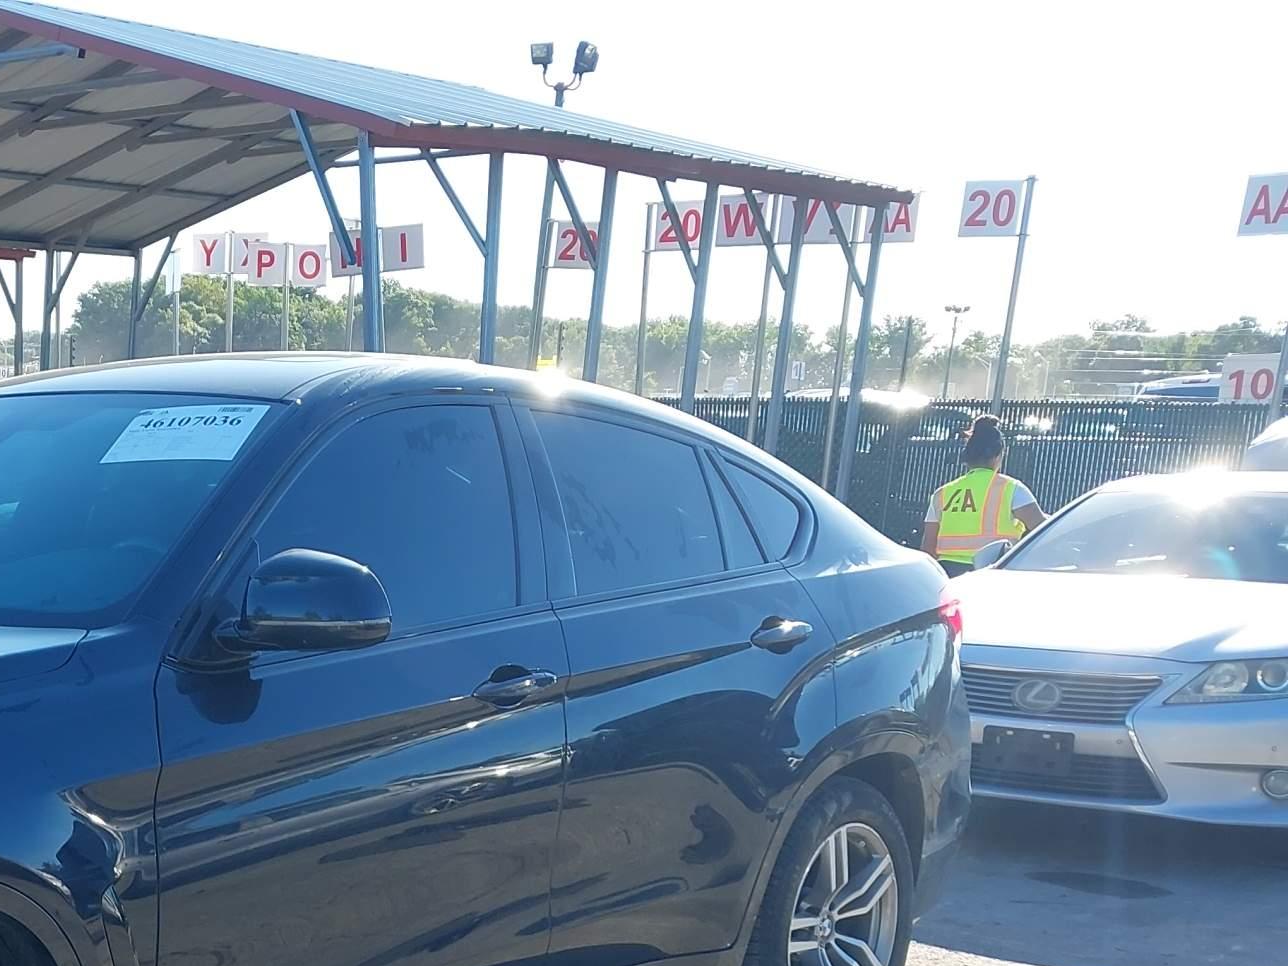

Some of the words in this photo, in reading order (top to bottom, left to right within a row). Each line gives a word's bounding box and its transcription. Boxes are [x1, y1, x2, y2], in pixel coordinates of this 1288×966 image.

[964, 189, 1016, 227] 20
[658, 209, 701, 243] 20
[200, 239, 218, 267] Y
[257, 249, 275, 278] P
[1228, 368, 1274, 400] 10
[139, 415, 244, 429] 46107036
